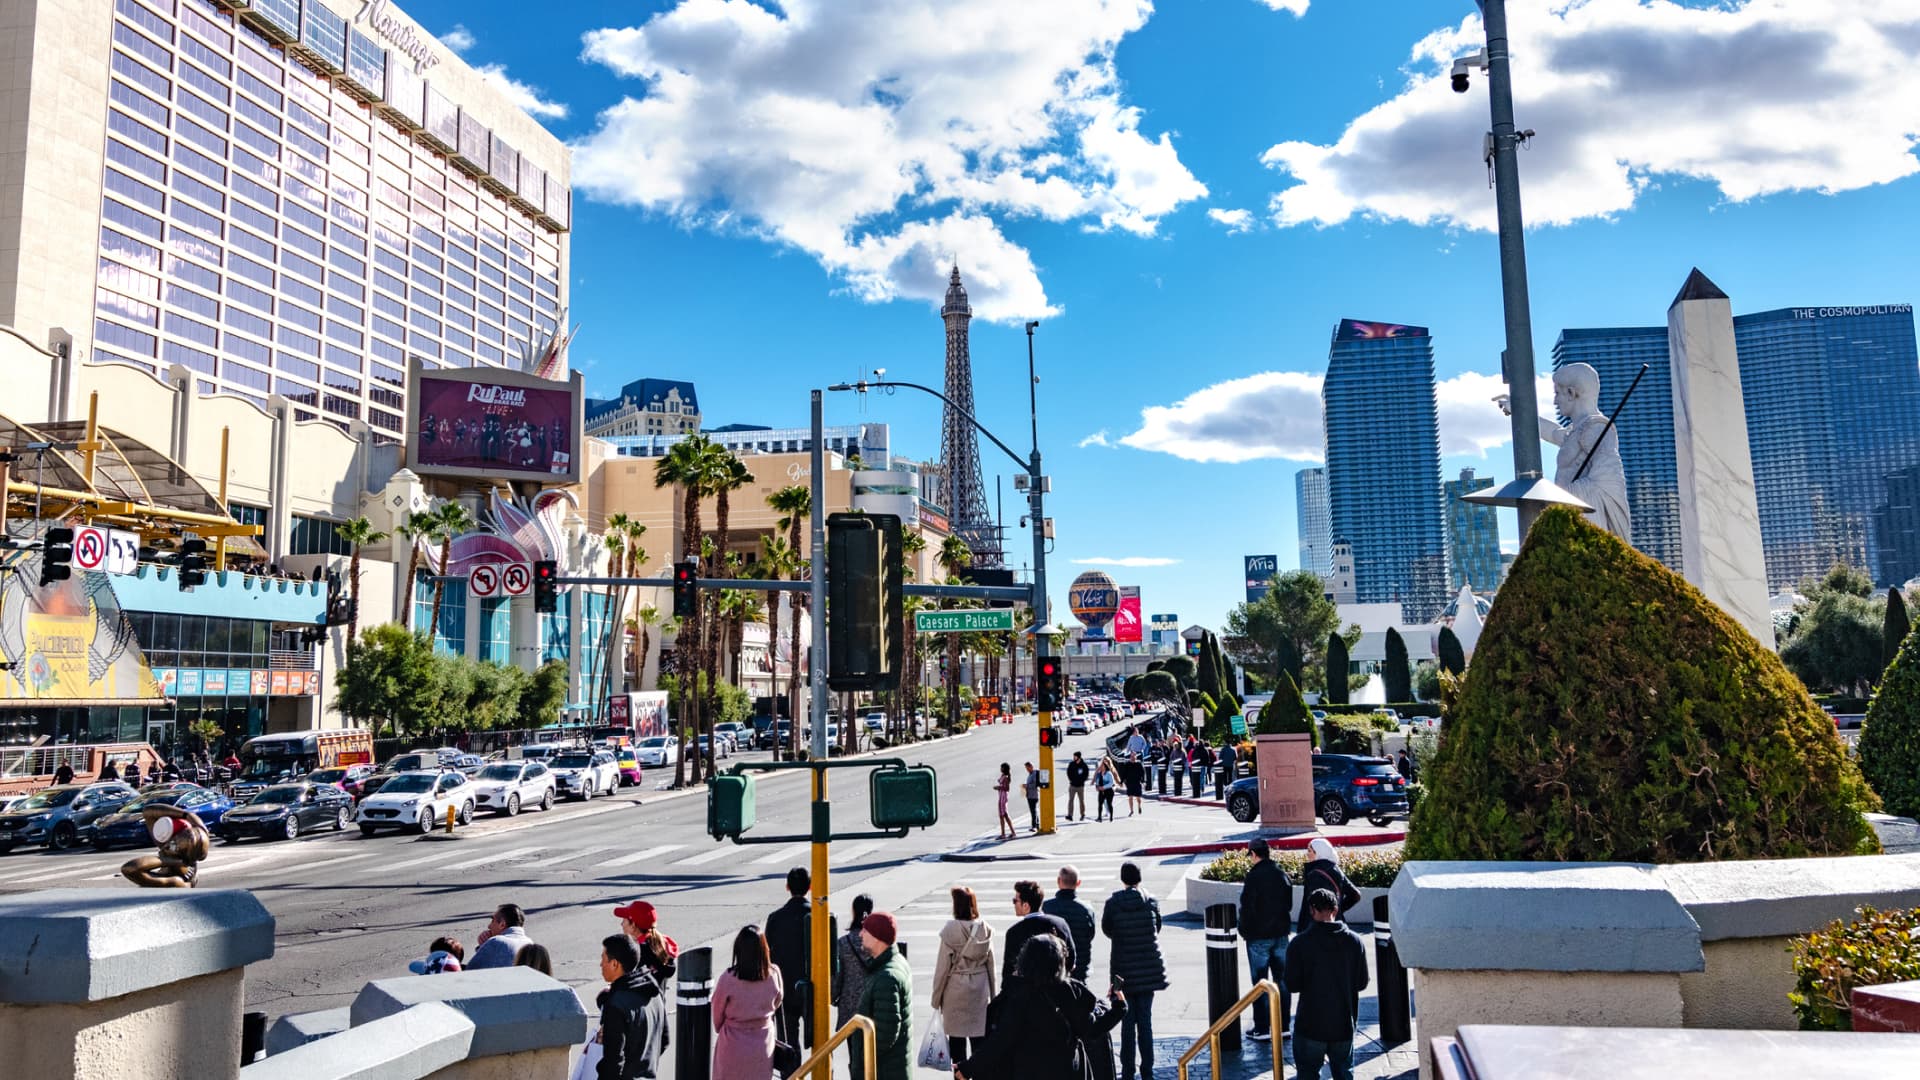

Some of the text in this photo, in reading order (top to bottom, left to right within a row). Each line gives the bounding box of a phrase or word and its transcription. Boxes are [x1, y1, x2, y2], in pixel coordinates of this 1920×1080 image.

[1792, 303, 1912, 320] THE COSMOPOLITAN
[486, 404, 510, 416] LIVE
[919, 615, 960, 629] Caesars
[965, 614, 998, 628] Palace
[1151, 621, 1179, 631] MGM
